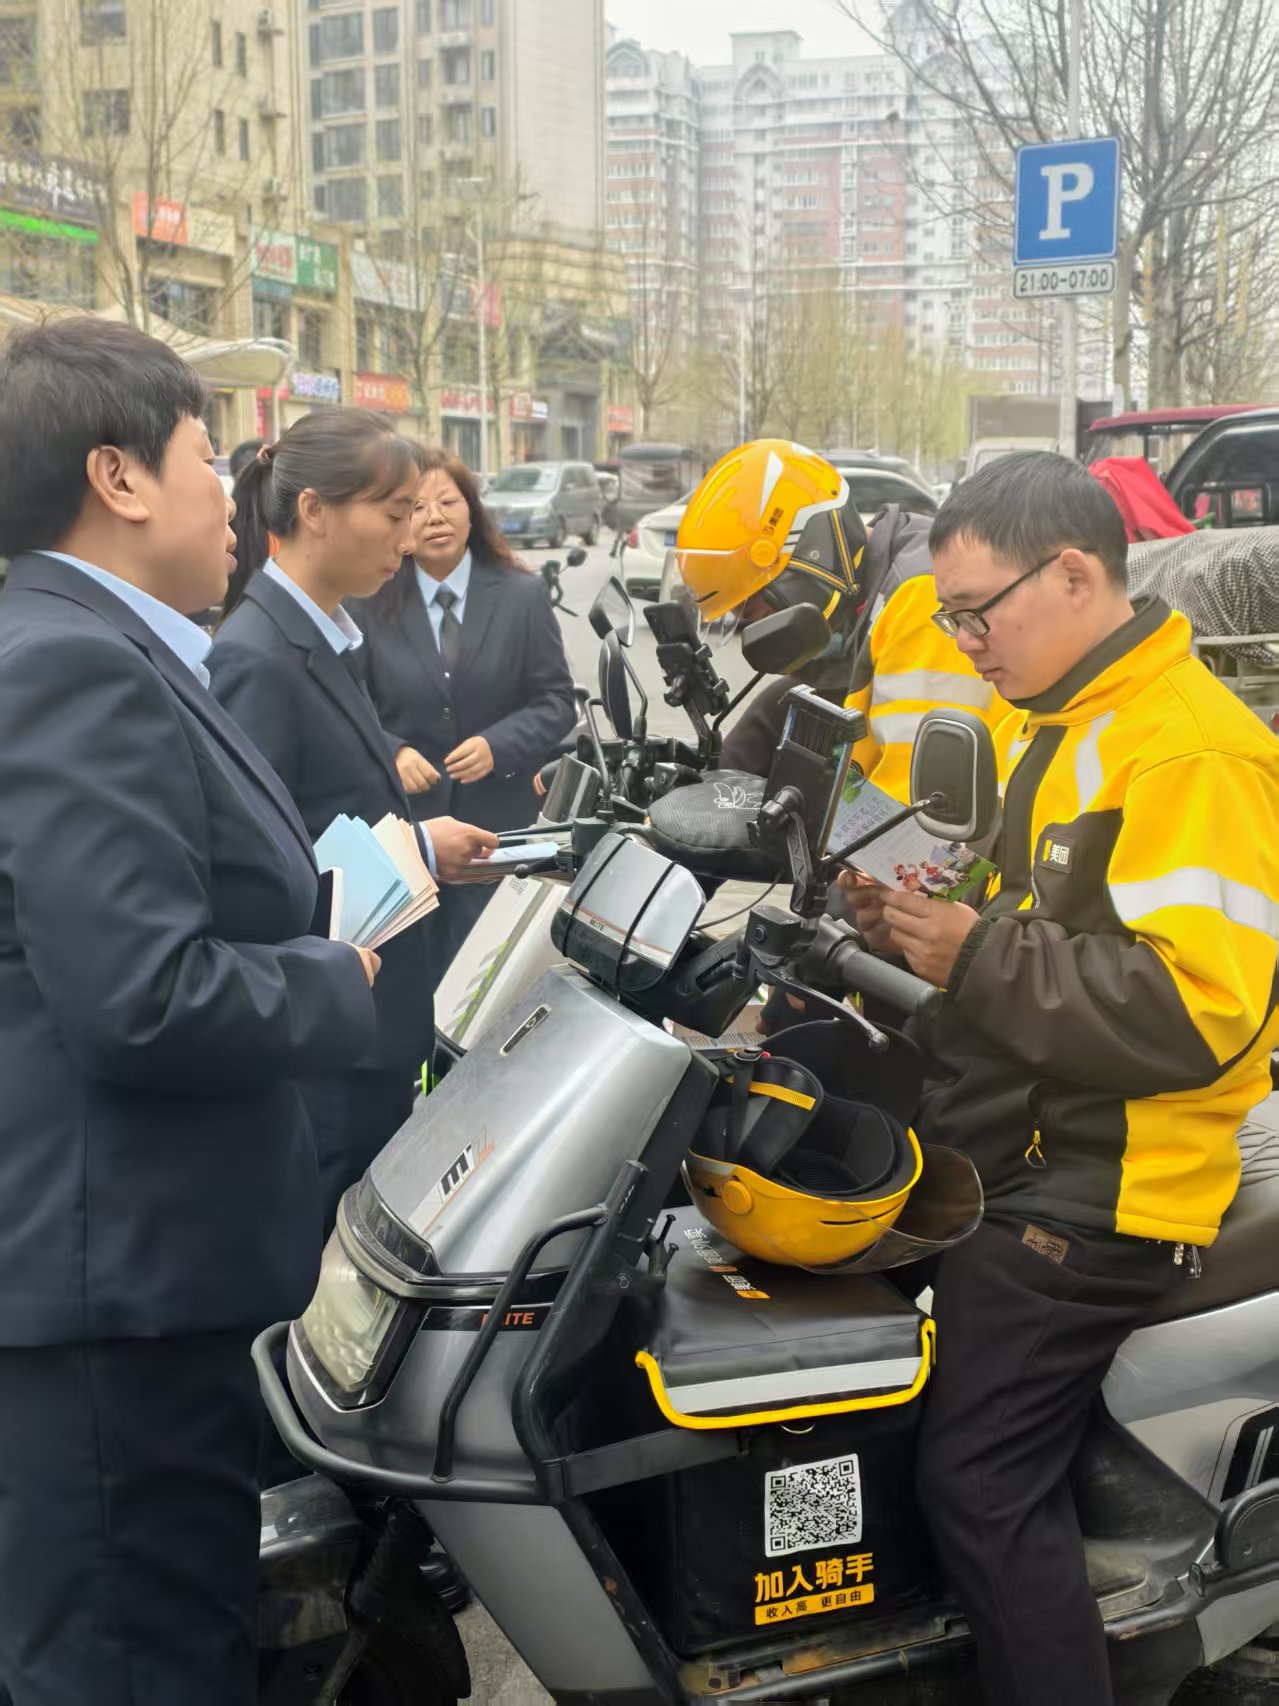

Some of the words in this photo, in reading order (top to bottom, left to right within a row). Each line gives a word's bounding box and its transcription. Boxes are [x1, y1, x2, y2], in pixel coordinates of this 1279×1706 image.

[1039, 162, 1094, 241] P
[1020, 268, 1109, 293] 21:00-07:00
[1049, 843, 1070, 865] 美团
[481, 1312, 535, 1326] ITE
[754, 1552, 874, 1603] 加入骑手
[766, 1600, 807, 1619] 收入高
[821, 1590, 862, 1608] 更自由
